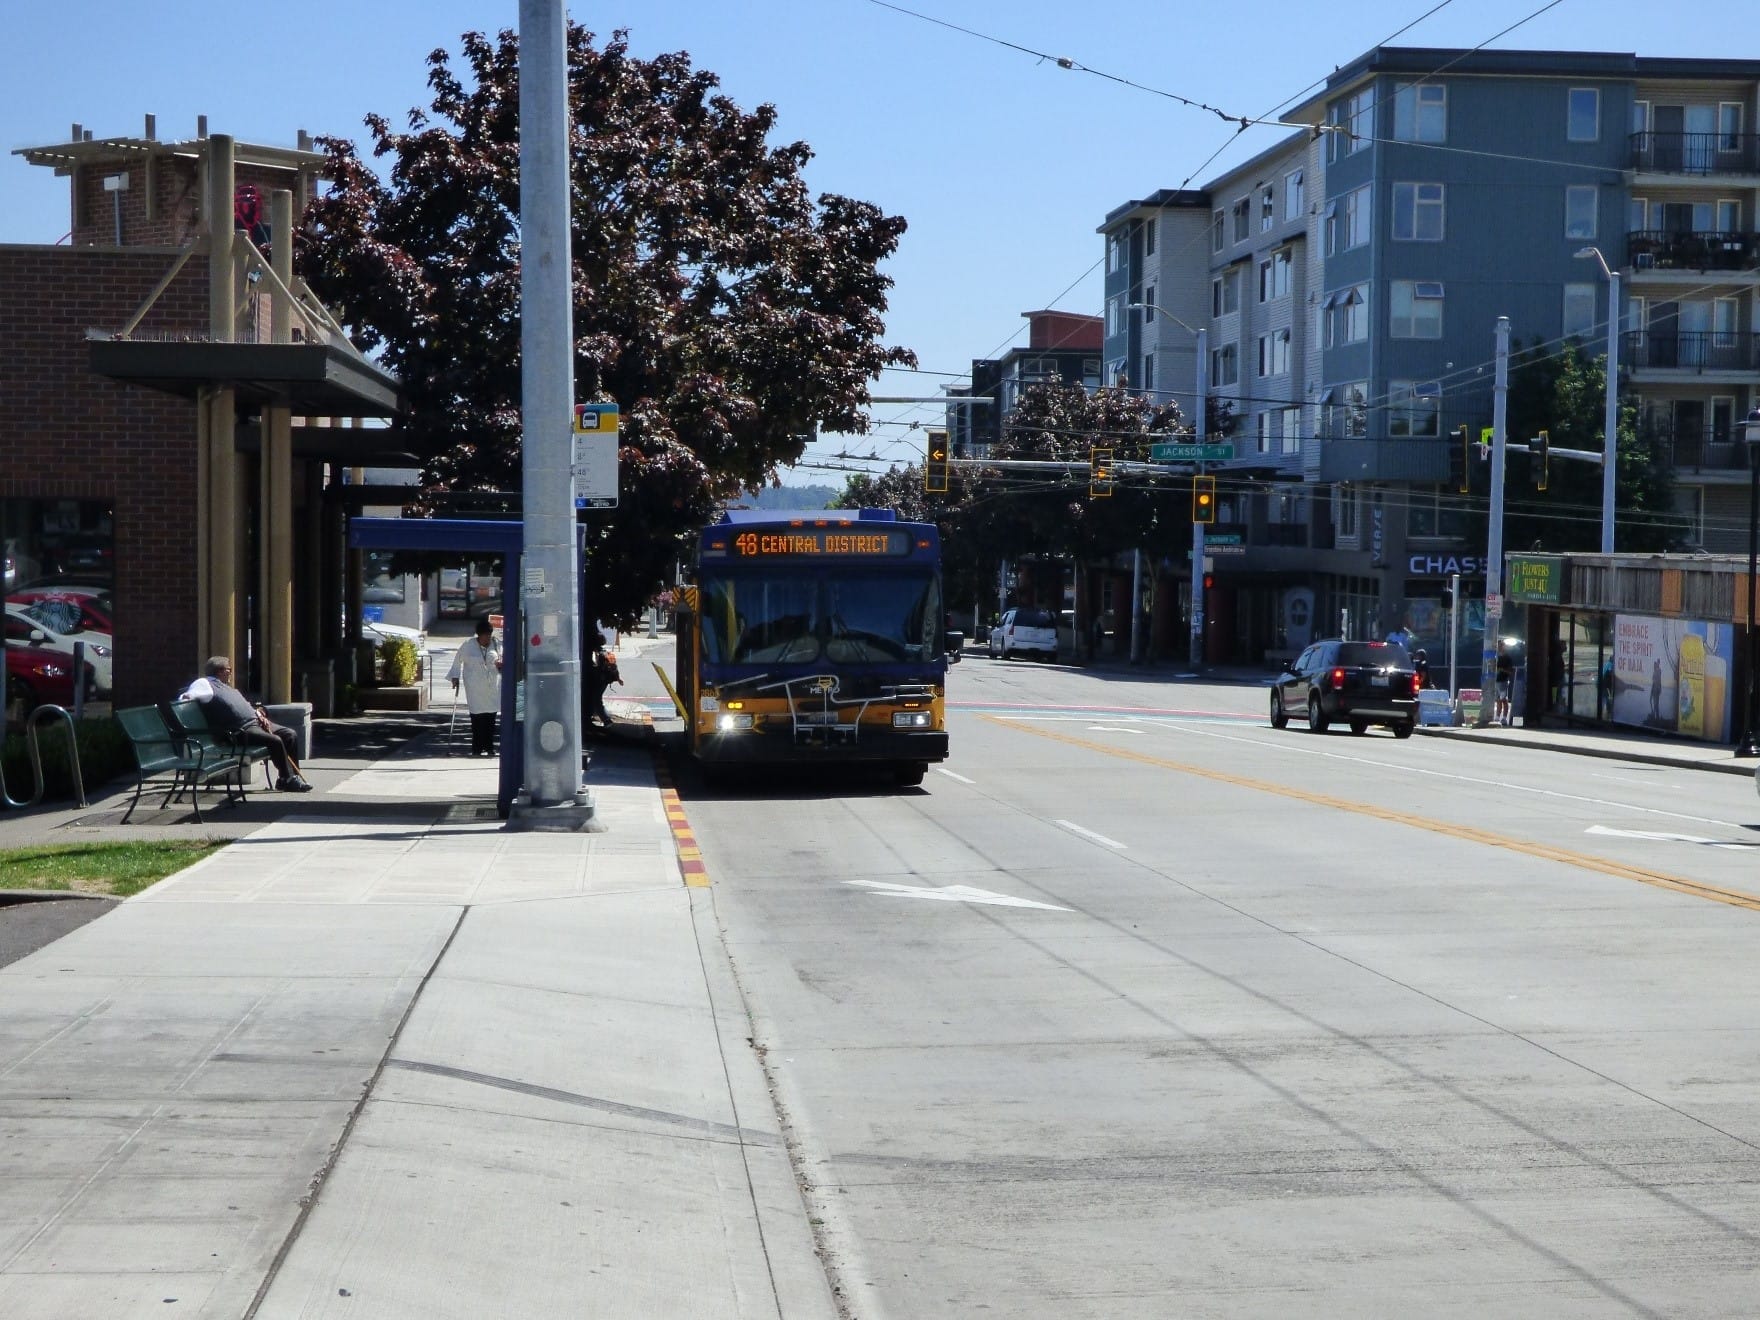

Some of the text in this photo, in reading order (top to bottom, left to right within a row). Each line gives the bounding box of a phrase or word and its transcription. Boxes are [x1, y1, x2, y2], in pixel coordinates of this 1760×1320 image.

[1160, 448, 1203, 457] JACKSON
[735, 533, 888, 555] 48 CENTRAL DISTRICT
[1618, 624, 1649, 639] EMBRACE
[1618, 640, 1653, 657] THE SPIRIT
[1618, 656, 1627, 671] OF
